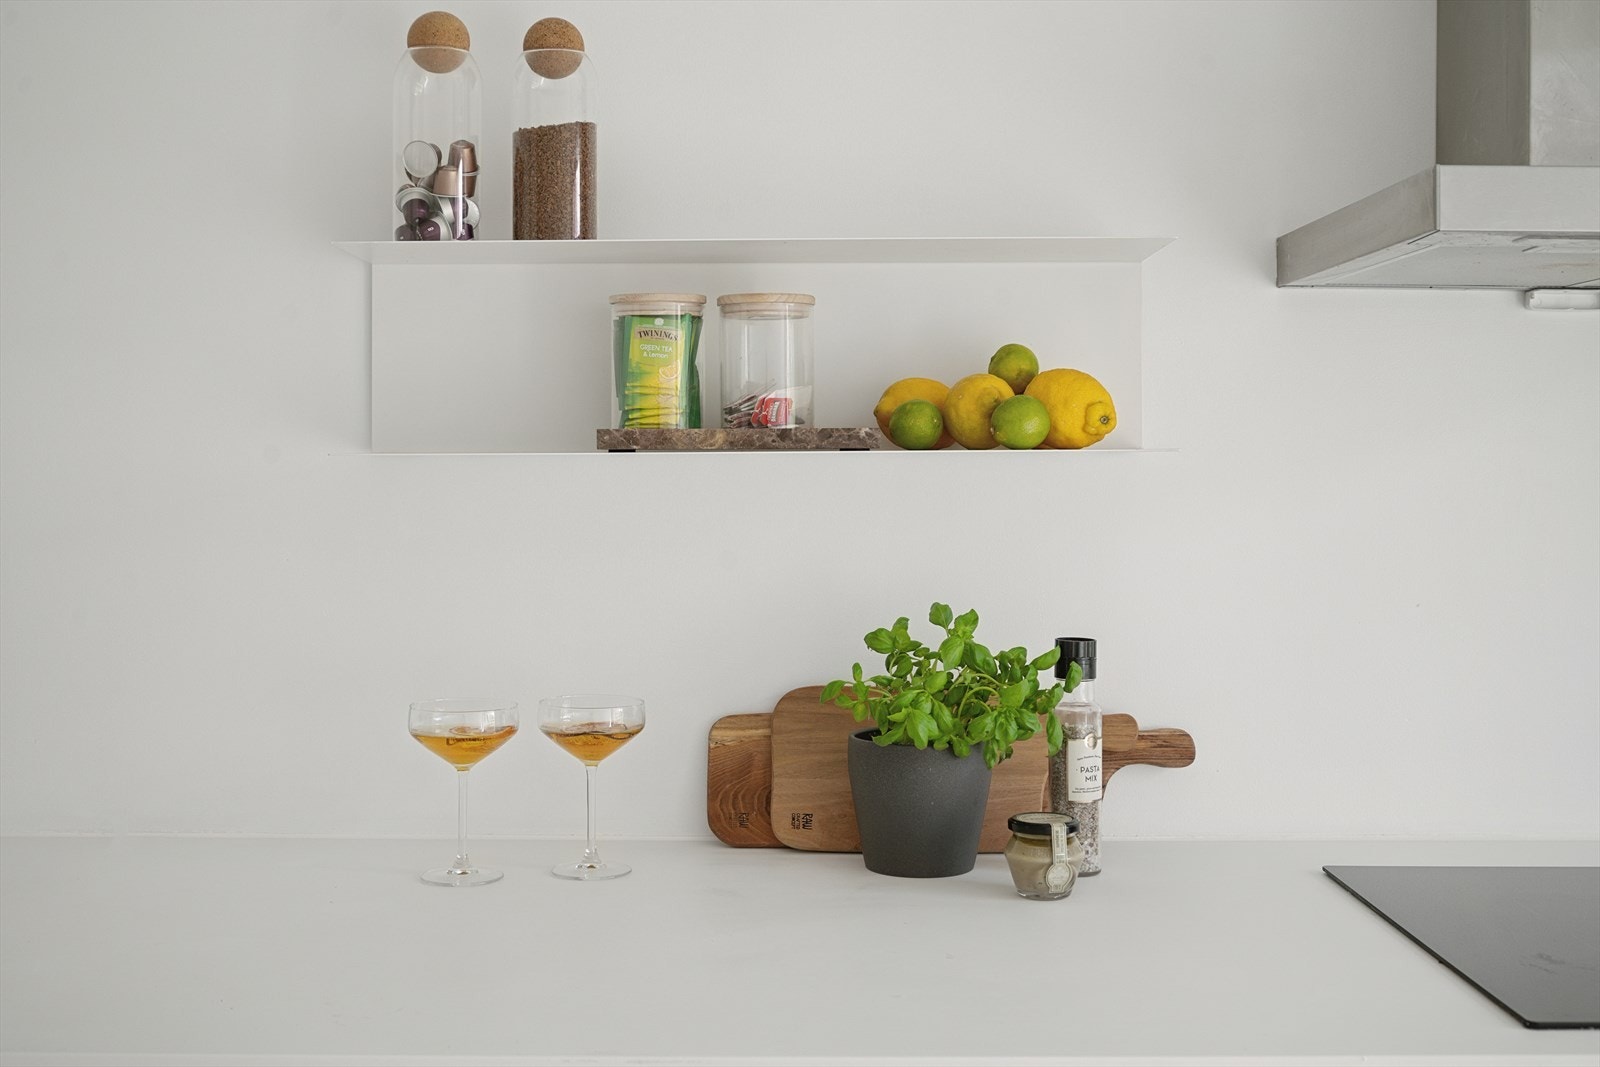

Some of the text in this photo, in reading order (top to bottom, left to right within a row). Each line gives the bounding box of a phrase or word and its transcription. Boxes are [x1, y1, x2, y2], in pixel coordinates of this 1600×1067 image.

[638, 329, 678, 341] TWININGS
[640, 343, 673, 353] GREEN TEA
[1080, 765, 1100, 774] PASTA
[738, 812, 749, 829] RAW
[802, 813, 813, 830] RAW
